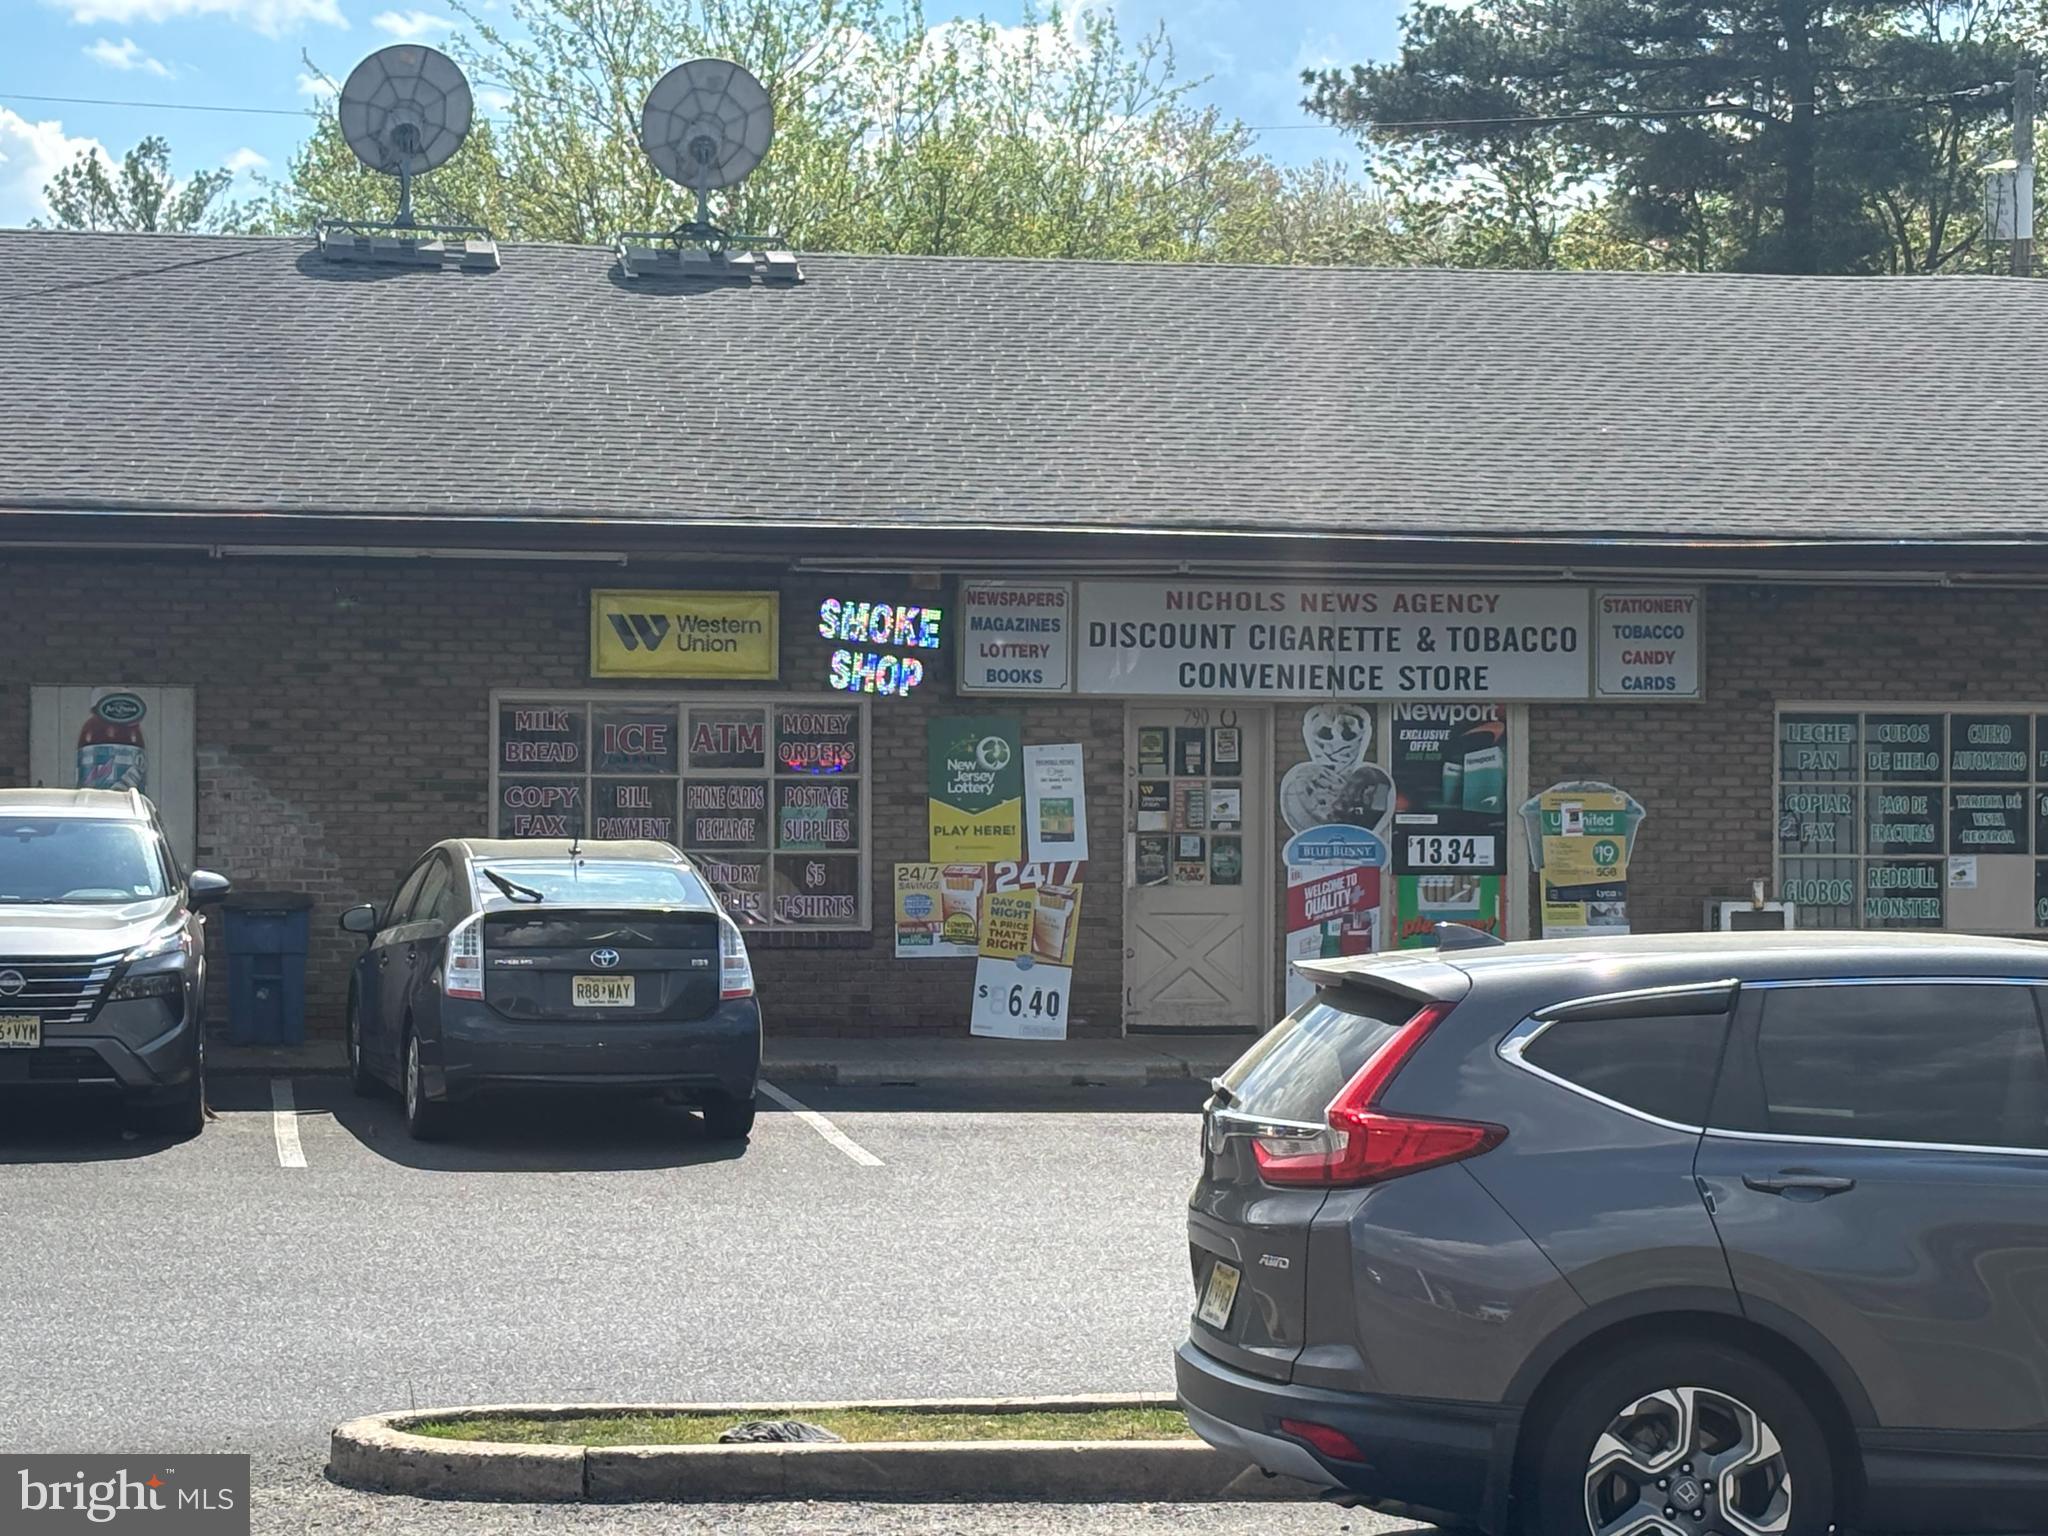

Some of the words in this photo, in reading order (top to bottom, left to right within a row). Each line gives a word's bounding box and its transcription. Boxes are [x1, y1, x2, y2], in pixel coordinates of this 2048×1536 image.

[967, 590, 1065, 608] NEWSPAPERS
[1166, 590, 1286, 612] NICHOLS
[1301, 591, 1378, 613] NEWS
[1392, 592, 1501, 614] AGENCY
[1603, 598, 1695, 614] STATIONERY
[676, 614, 762, 635] Western
[818, 597, 943, 649] SMOKE
[970, 616, 1061, 633] MAGAZINES
[1612, 624, 1685, 641] TOBACCO
[677, 633, 738, 653] Union
[1089, 621, 1237, 650] DISCOUNT
[1248, 624, 1403, 652] CIGARETTE
[1416, 626, 1436, 653] &
[1446, 626, 1577, 653] TOBACCO
[980, 642, 1050, 659] LOTTERY
[1622, 650, 1675, 666] CANDY
[828, 648, 924, 697] SHOP
[986, 668, 1043, 685] BOOKS
[1178, 661, 1384, 691] CONVENIENCE
[1399, 664, 1490, 692] STORE
[1621, 675, 1676, 692] CARDS
[515, 710, 569, 732] MILK
[783, 713, 851, 734] MONEY
[1184, 708, 1210, 727] 790
[1393, 703, 1500, 727] Newport
[604, 724, 667, 755] ICE
[690, 723, 764, 754] ATM
[1400, 729, 1452, 741] EXCLUSIVE
[1787, 723, 1850, 744] LECHE
[1879, 724, 1930, 743] CUBOS
[505, 741, 579, 763] BREAD
[779, 742, 855, 763] ORDERS
[1409, 741, 1440, 752] OFFER
[947, 758, 977, 772] New
[1798, 751, 1839, 770] PAN
[1868, 752, 1891, 770] DE
[1893, 752, 1940, 771] HIELO
[953, 771, 996, 784] Jersey
[504, 785, 579, 808] COPY
[616, 785, 652, 809] BILL
[687, 785, 726, 809] PHONE
[727, 785, 765, 810] CARDS
[784, 786, 849, 809] POSTAGE
[947, 782, 996, 796] Lottery
[1785, 793, 1852, 814] COPIAR
[1878, 795, 1910, 815] PAGO
[1911, 796, 1928, 815] DE
[515, 814, 569, 837] FAX
[597, 816, 671, 839] PAYMENT
[696, 817, 755, 842] RECHARGE
[783, 818, 850, 842] SUPPLIES
[934, 825, 969, 837] PLAY
[974, 824, 1017, 837] HERE!
[1801, 822, 1836, 842] FAX
[1303, 845, 1331, 857] BLUE
[1332, 845, 1373, 857] BUNNY
[701, 864, 761, 884] AUNDRY
[805, 861, 826, 888] $5
[898, 866, 940, 882] 24/7
[1867, 867, 1939, 889] REDBULL
[898, 881, 940, 891] SAVINGS
[1304, 877, 1346, 900] WELCOME
[1345, 873, 1358, 888] TO
[1783, 879, 1853, 905] GLOBOS
[778, 895, 855, 918] T-SHIRTS
[991, 896, 1016, 907] DAY
[1305, 888, 1352, 920] QUALITY
[1866, 897, 1940, 919] MONSTER
[990, 906, 1032, 920] NIGHT
[988, 928, 1029, 942] THAT'S
[990, 919, 998, 928] A
[999, 920, 1030, 931] PRICE
[986, 938, 1028, 953] RIGHT
[1008, 984, 1060, 1019] 6.40
[1258, 1254, 1290, 1269] AWD
